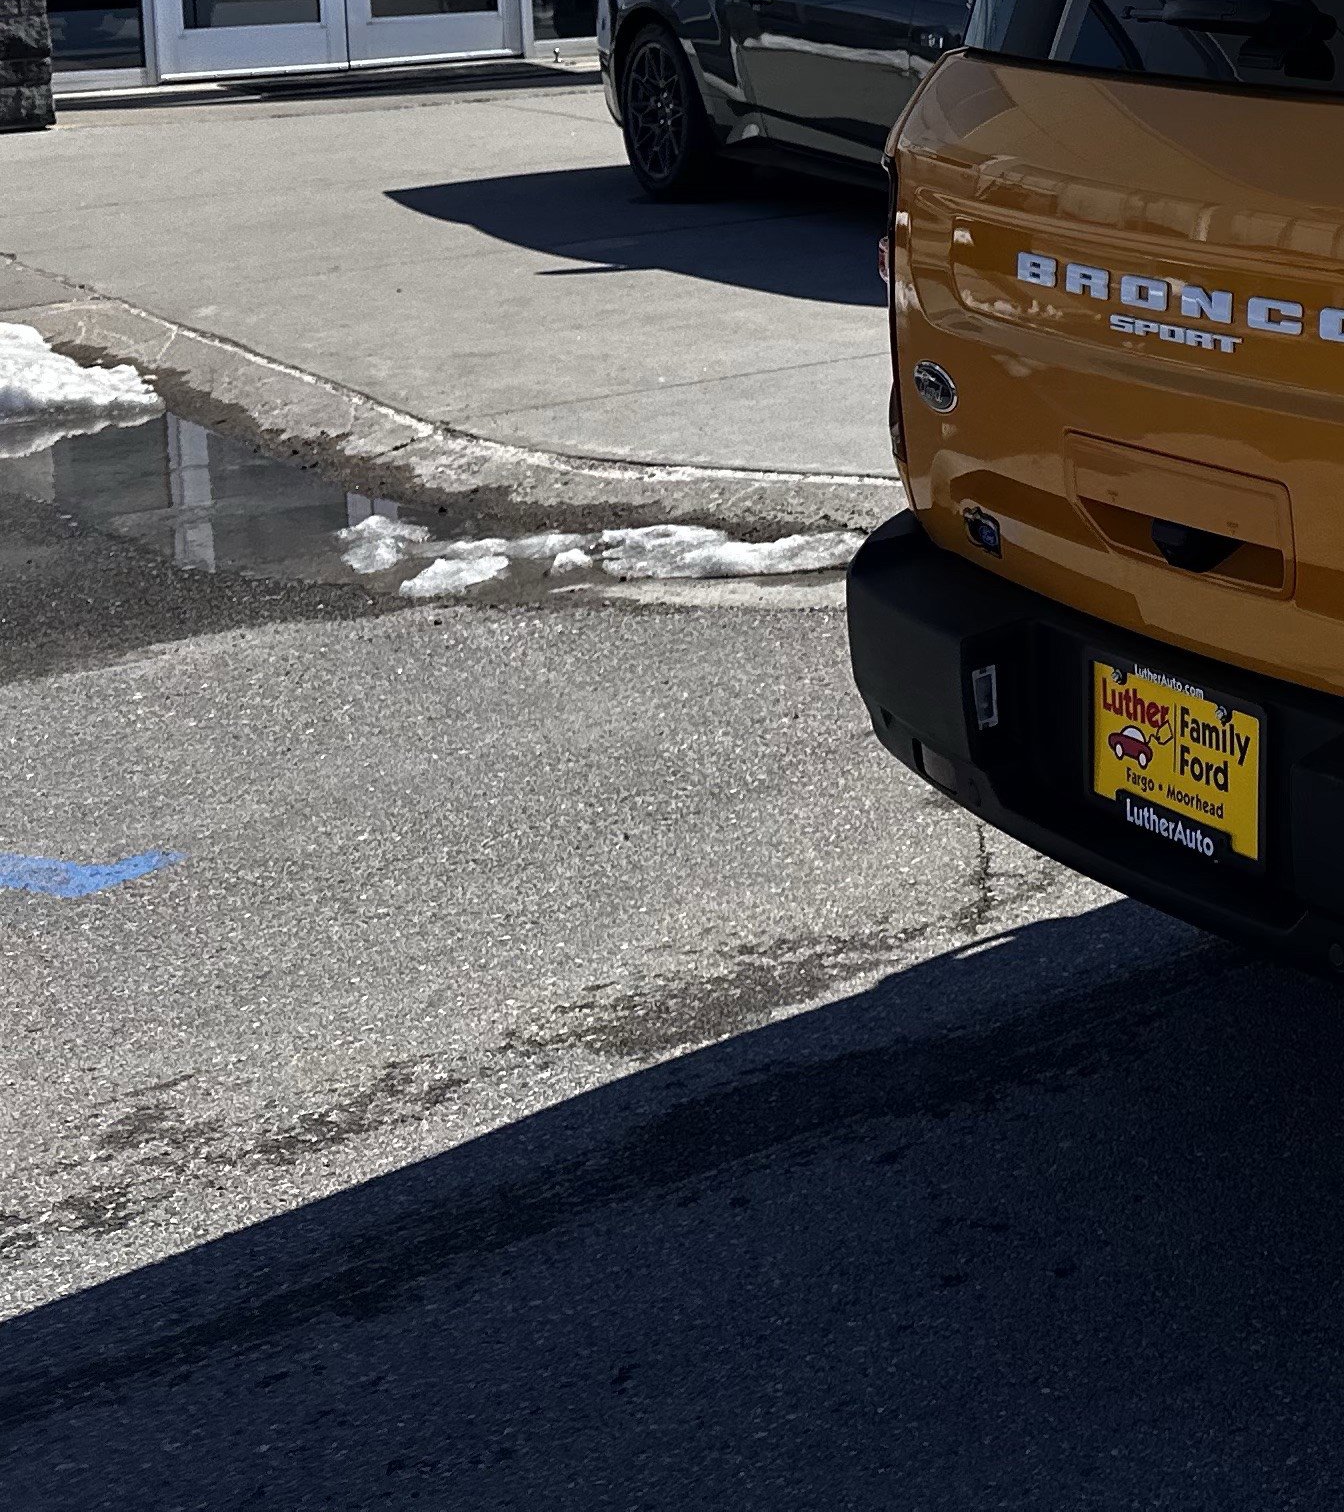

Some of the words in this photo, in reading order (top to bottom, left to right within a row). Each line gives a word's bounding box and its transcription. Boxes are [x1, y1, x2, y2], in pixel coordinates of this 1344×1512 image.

[1110, 314, 1243, 354] SPORT
[1101, 678, 1170, 729] Luther
[1134, 663, 1204, 700] LutherAuto.com
[1179, 705, 1251, 767] Family
[1126, 767, 1155, 793] Fargo
[1166, 784, 1224, 820] Moorhead
[1179, 744, 1229, 793] Ford
[1126, 798, 1215, 857] LutherAuto
